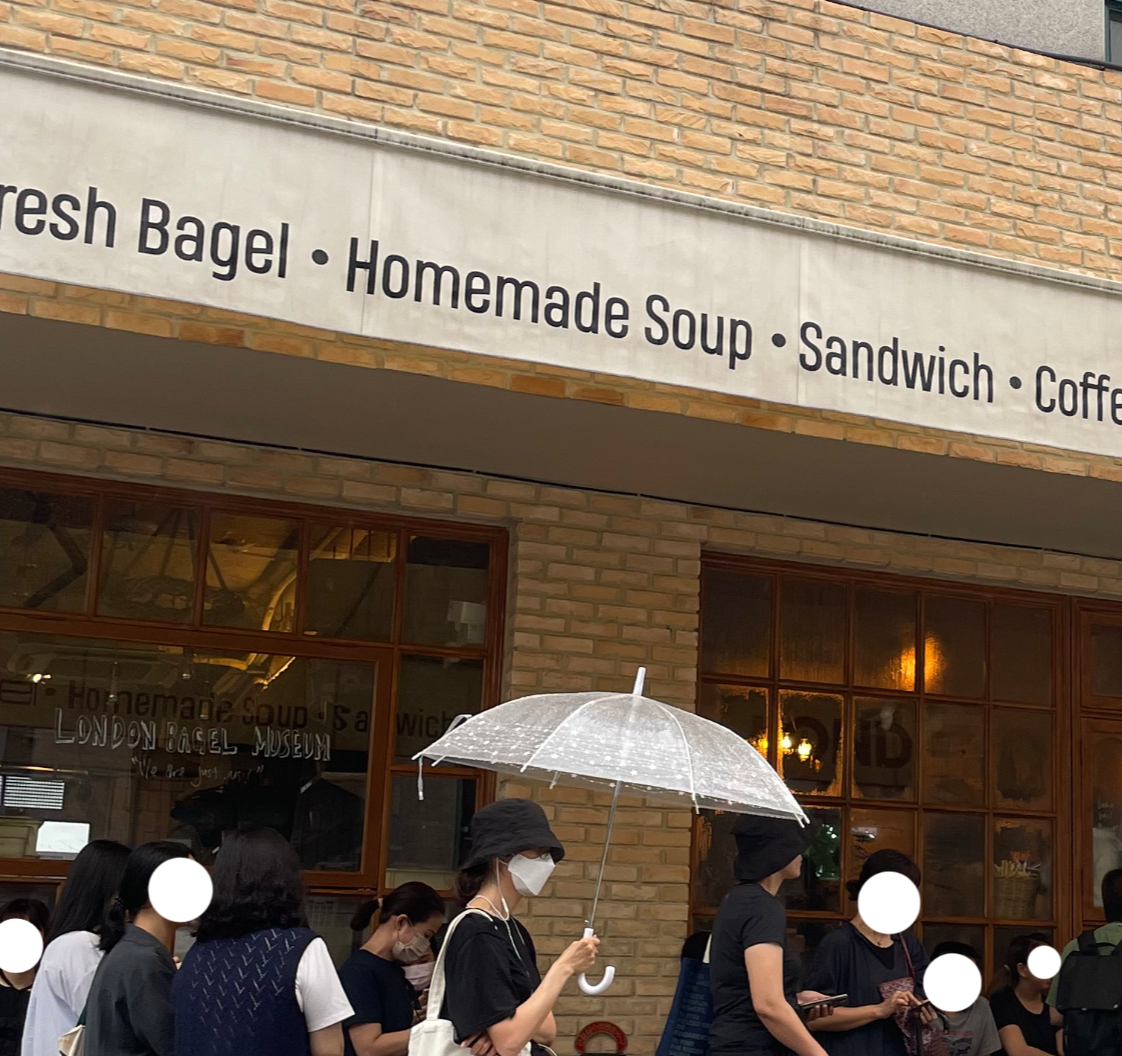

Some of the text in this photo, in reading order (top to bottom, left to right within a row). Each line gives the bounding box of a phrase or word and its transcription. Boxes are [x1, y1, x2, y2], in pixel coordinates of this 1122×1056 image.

[138, 197, 289, 282] Bagel
[346, 237, 629, 339] Homemade
[644, 294, 752, 370] Soup
[799, 321, 994, 404] Sandwich
[54, 708, 331, 762] LONDON BAGEL MUSEUM
